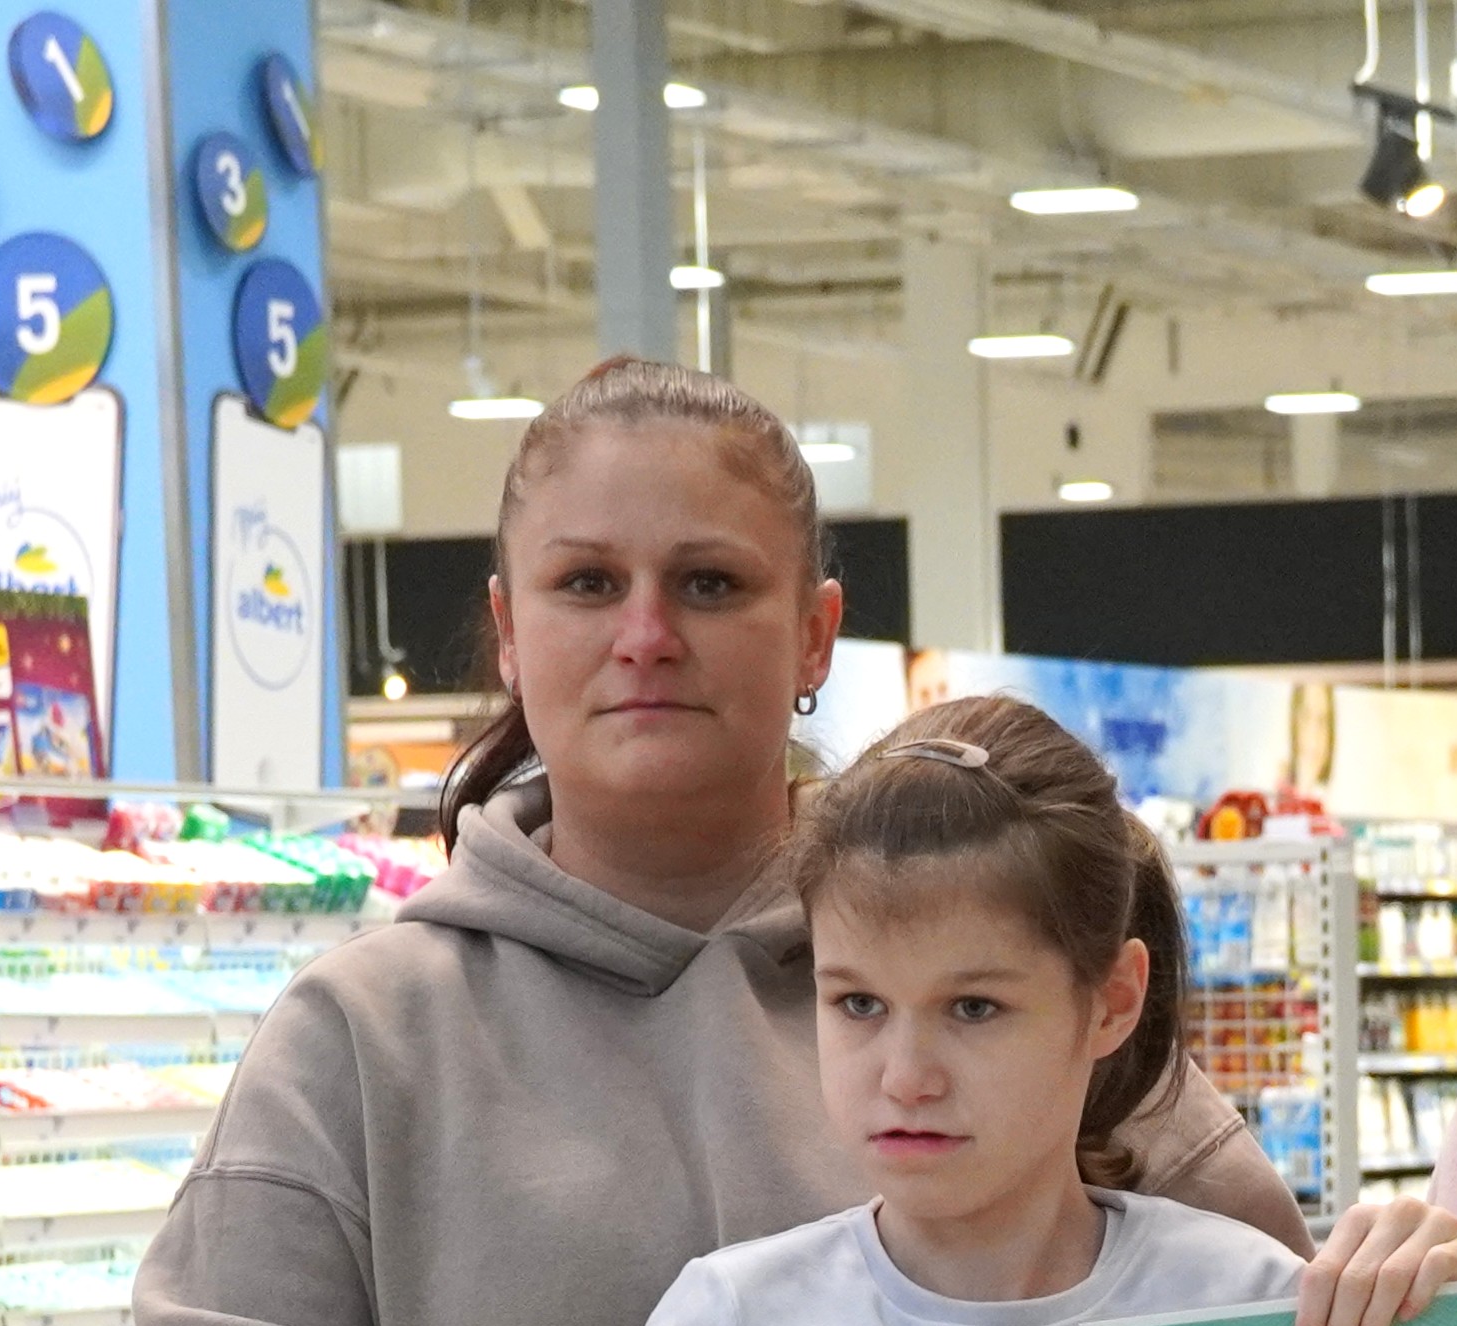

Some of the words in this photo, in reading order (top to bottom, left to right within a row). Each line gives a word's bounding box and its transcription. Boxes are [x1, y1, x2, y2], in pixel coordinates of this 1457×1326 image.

[42, 34, 84, 103] 1
[283, 79, 311, 138] 1
[215, 150, 248, 216] 3
[14, 273, 61, 355] 5
[265, 299, 298, 378] 5
